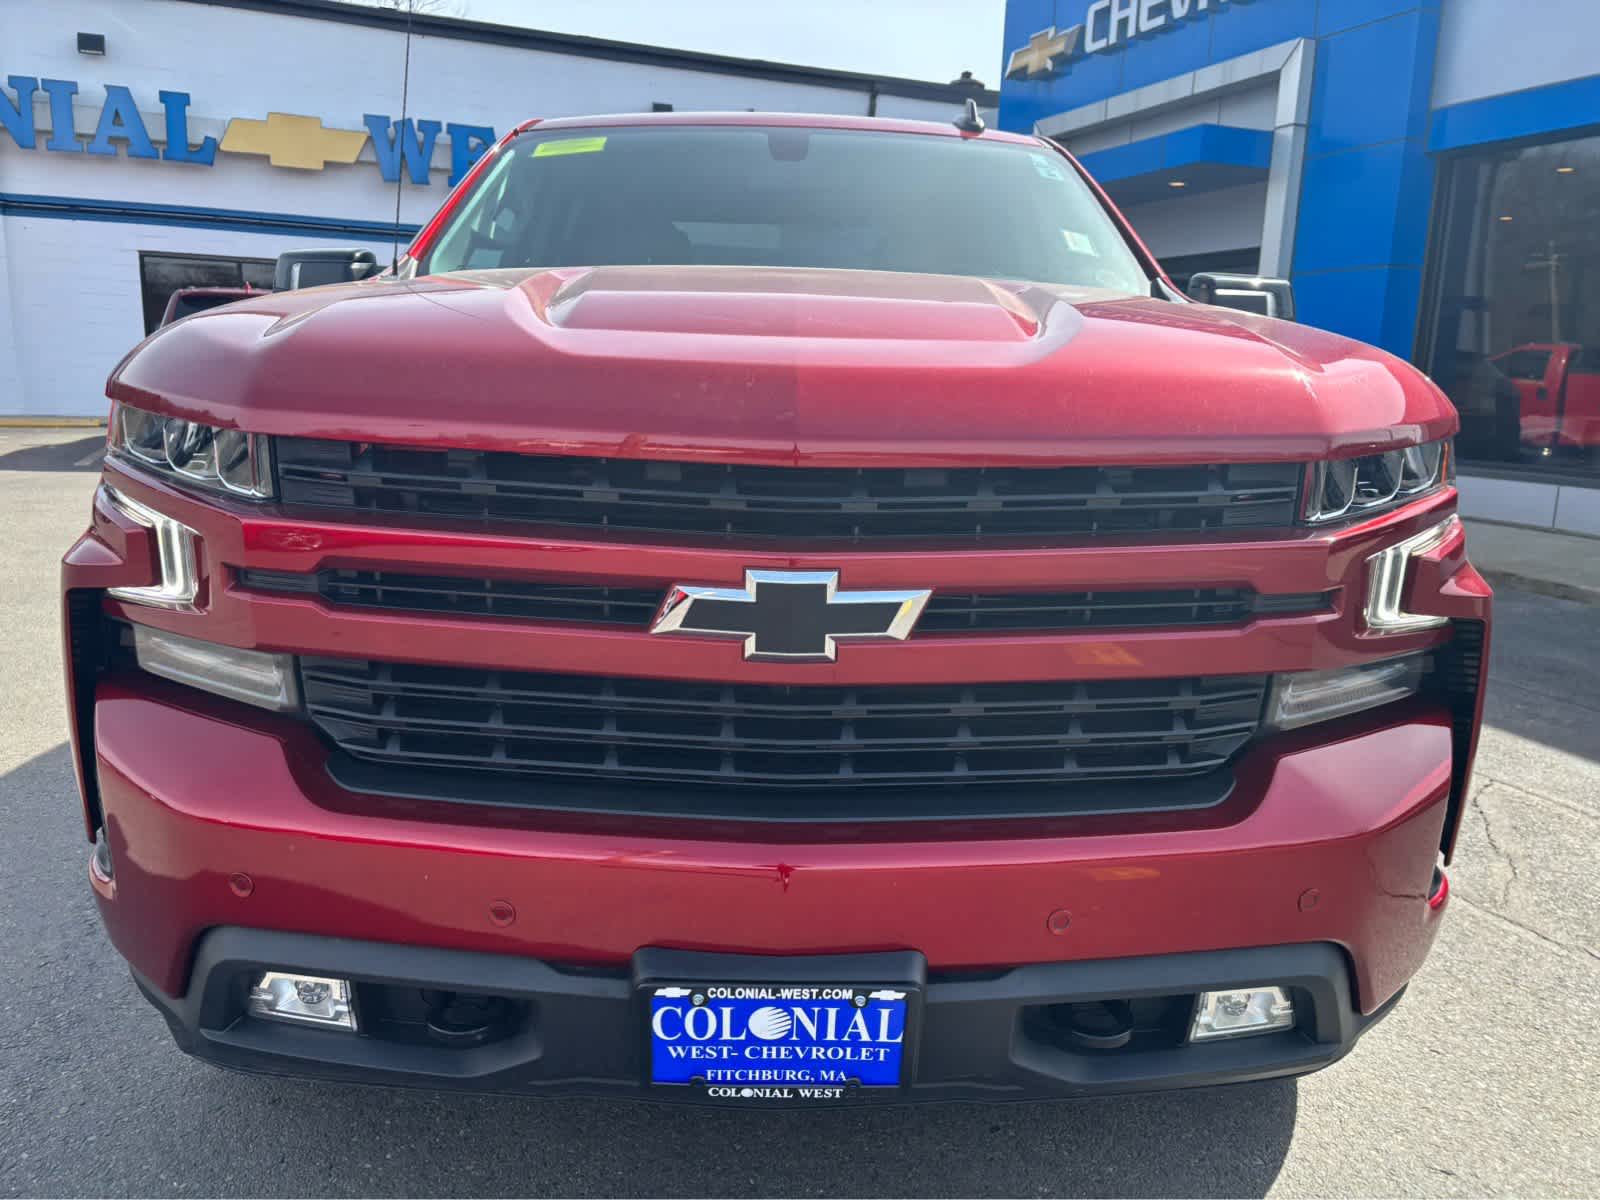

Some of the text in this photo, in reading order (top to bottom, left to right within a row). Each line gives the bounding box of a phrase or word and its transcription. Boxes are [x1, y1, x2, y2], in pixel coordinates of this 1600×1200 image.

[1084, 0, 1229, 53] CHE
[707, 987, 853, 1000] COLONIAL-WEST.COM
[652, 1006, 904, 1043] COLONIAL
[744, 1045, 890, 1061] CHEVROLET
[706, 1069, 847, 1083] FITCHBURG, MA
[708, 1087, 843, 1098] COLONIAL WEST
